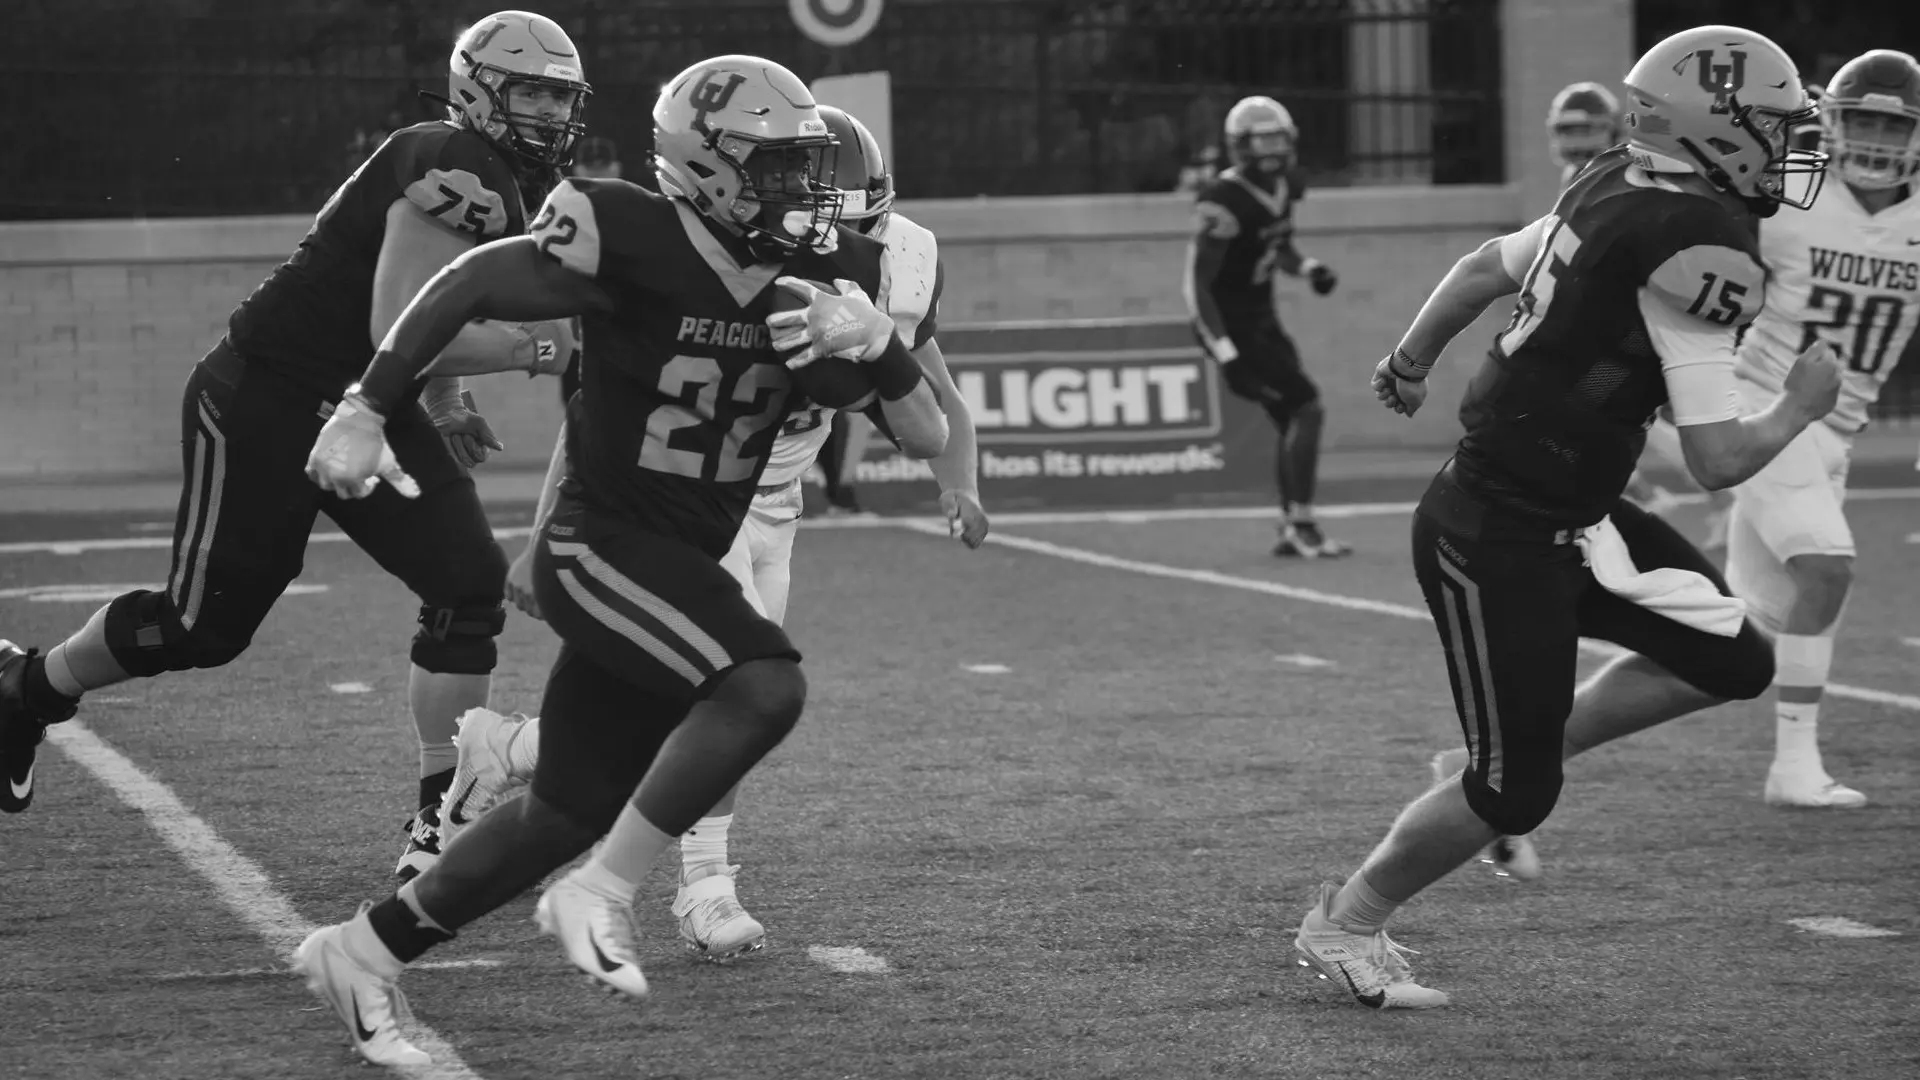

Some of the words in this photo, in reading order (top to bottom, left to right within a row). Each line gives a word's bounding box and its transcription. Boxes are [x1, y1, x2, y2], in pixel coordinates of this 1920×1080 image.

[424, 183, 492, 236] 75
[1809, 247, 1919, 291] WOLVES
[1686, 271, 1748, 326] 15
[676, 315, 769, 349] PEACOC
[1798, 284, 1905, 375] 20
[637, 354, 790, 483] 22
[957, 365, 1199, 428] LIGHT
[981, 450, 1040, 478] has
[1042, 449, 1083, 476] its
